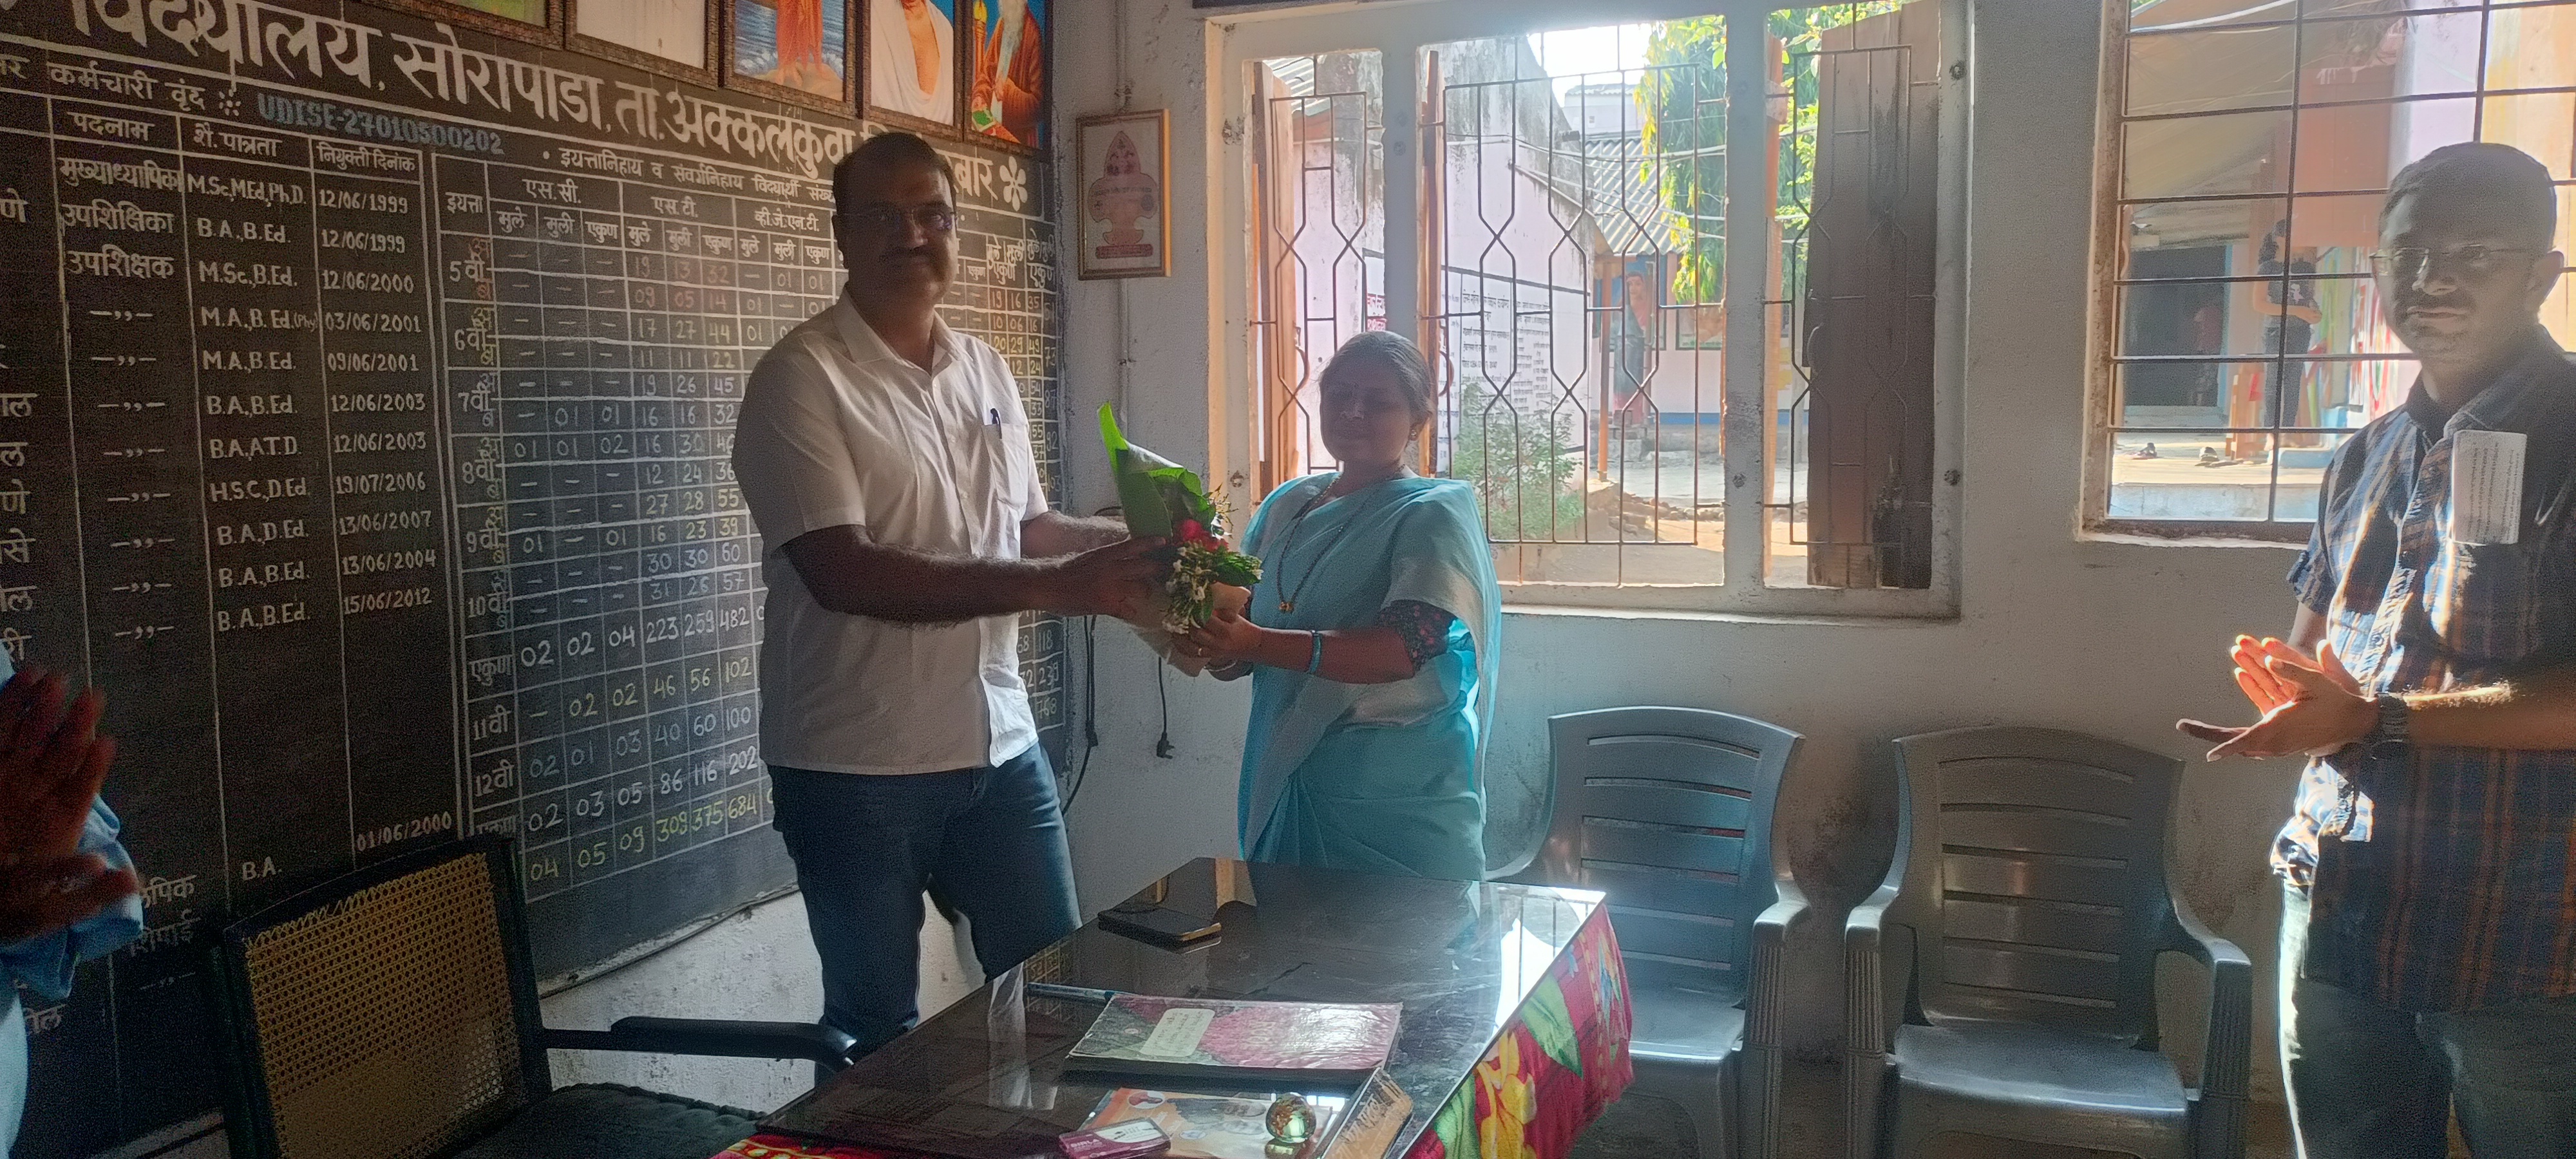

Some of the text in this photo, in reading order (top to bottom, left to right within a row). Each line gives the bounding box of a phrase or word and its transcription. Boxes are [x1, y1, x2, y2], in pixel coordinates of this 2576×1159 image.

[46, 59, 159, 100] कर्मचारी
[66, 111, 156, 142] पदनाम
[219, 131, 283, 157] पात्रता
[319, 189, 409, 214] 12/06/1999
[61, 198, 175, 234] उपशिक्षिका
[496, 206, 528, 233] मुले
[544, 211, 575, 239] मुली
[584, 220, 619, 244] एकुण
[627, 221, 652, 247] मुले
[665, 227, 692, 251] मुली
[321, 229, 406, 254] 12/06/1999
[66, 243, 175, 279] उपशिक्षक
[635, 255, 650, 278] 19
[674, 259, 691, 279] 13
[707, 265, 730, 285] 32
[777, 270, 792, 288] 01
[808, 274, 823, 291] 01
[321, 269, 415, 294] 12/06/2000
[635, 286, 655, 308] 09
[674, 290, 695, 309] 05
[746, 296, 762, 313] 01
[325, 312, 422, 333] 03/06/2001
[638, 317, 657, 339] 17
[676, 319, 697, 341] 27
[708, 322, 731, 344] 44
[746, 322, 763, 342] 01
[327, 351, 420, 372] 09/06/2001
[641, 348, 654, 368] 11
[680, 350, 692, 369] 11
[712, 350, 736, 369] 22
[641, 373, 735, 396] 19 26 45
[330, 392, 426, 413] 12/06/2003
[554, 402, 738, 427] 01 01 16 16 32
[334, 431, 428, 453] 12/06/2003
[515, 438, 537, 459] 01
[556, 437, 578, 458] 01
[600, 433, 629, 455] 02
[645, 434, 661, 453] 16
[335, 471, 426, 495] 19/07/2006
[646, 464, 664, 485] 12
[682, 462, 703, 484] 24
[646, 487, 741, 515] 27 28 55
[339, 510, 432, 536] 13/06/2007
[522, 516, 739, 554] 01 01 16 23 39
[341, 549, 437, 576] 13/06/2004
[646, 542, 741, 573] 30 30 60
[687, 576, 710, 596] 26
[722, 570, 745, 592] 57
[343, 587, 432, 616] 15/06/2012
[520, 606, 750, 668] 02 02 04 223 259 482
[569, 655, 753, 718] 02 02 46 56 102
[529, 754, 561, 778] 02
[570, 740, 594, 767] 01
[614, 728, 642, 757] 03
[654, 722, 681, 747] 40
[693, 713, 717, 737] 60
[726, 706, 752, 731] 100
[527, 802, 564, 833] 02
[574, 789, 605, 818] 03
[616, 780, 643, 807] 05
[659, 768, 684, 795] 86
[694, 759, 718, 786] 116
[728, 745, 759, 777] 202
[241, 811, 451, 882] B.A. 01/06/2000
[529, 792, 759, 881] 04 05 09 309 375 684
